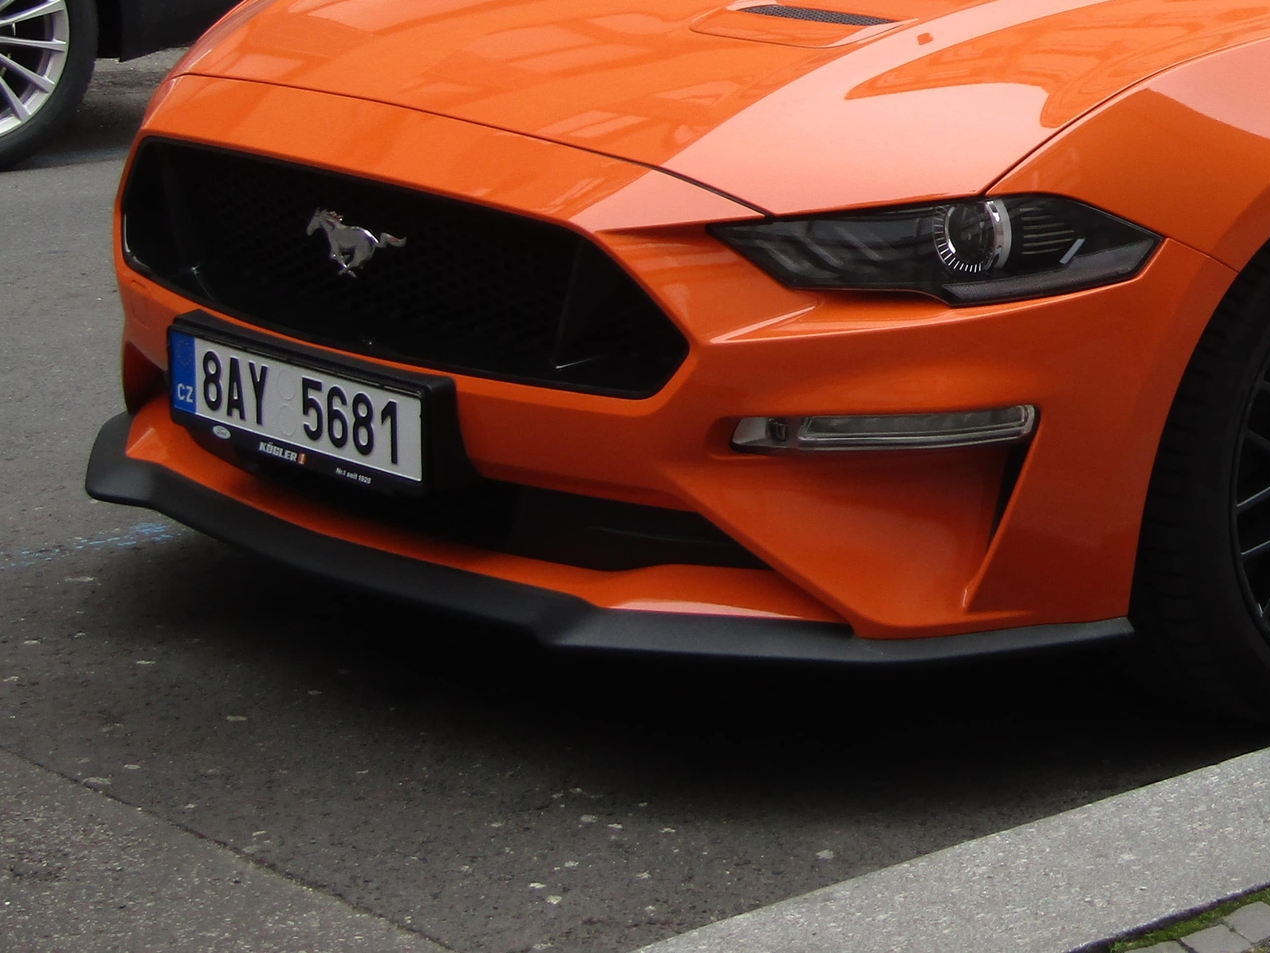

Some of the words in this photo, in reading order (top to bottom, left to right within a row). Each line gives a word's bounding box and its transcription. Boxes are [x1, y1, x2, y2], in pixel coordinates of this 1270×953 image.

[177, 382, 194, 403] CZ
[203, 350, 269, 426] 8AY
[301, 375, 398, 465] 5681
[259, 441, 298, 462] KÖGLER
